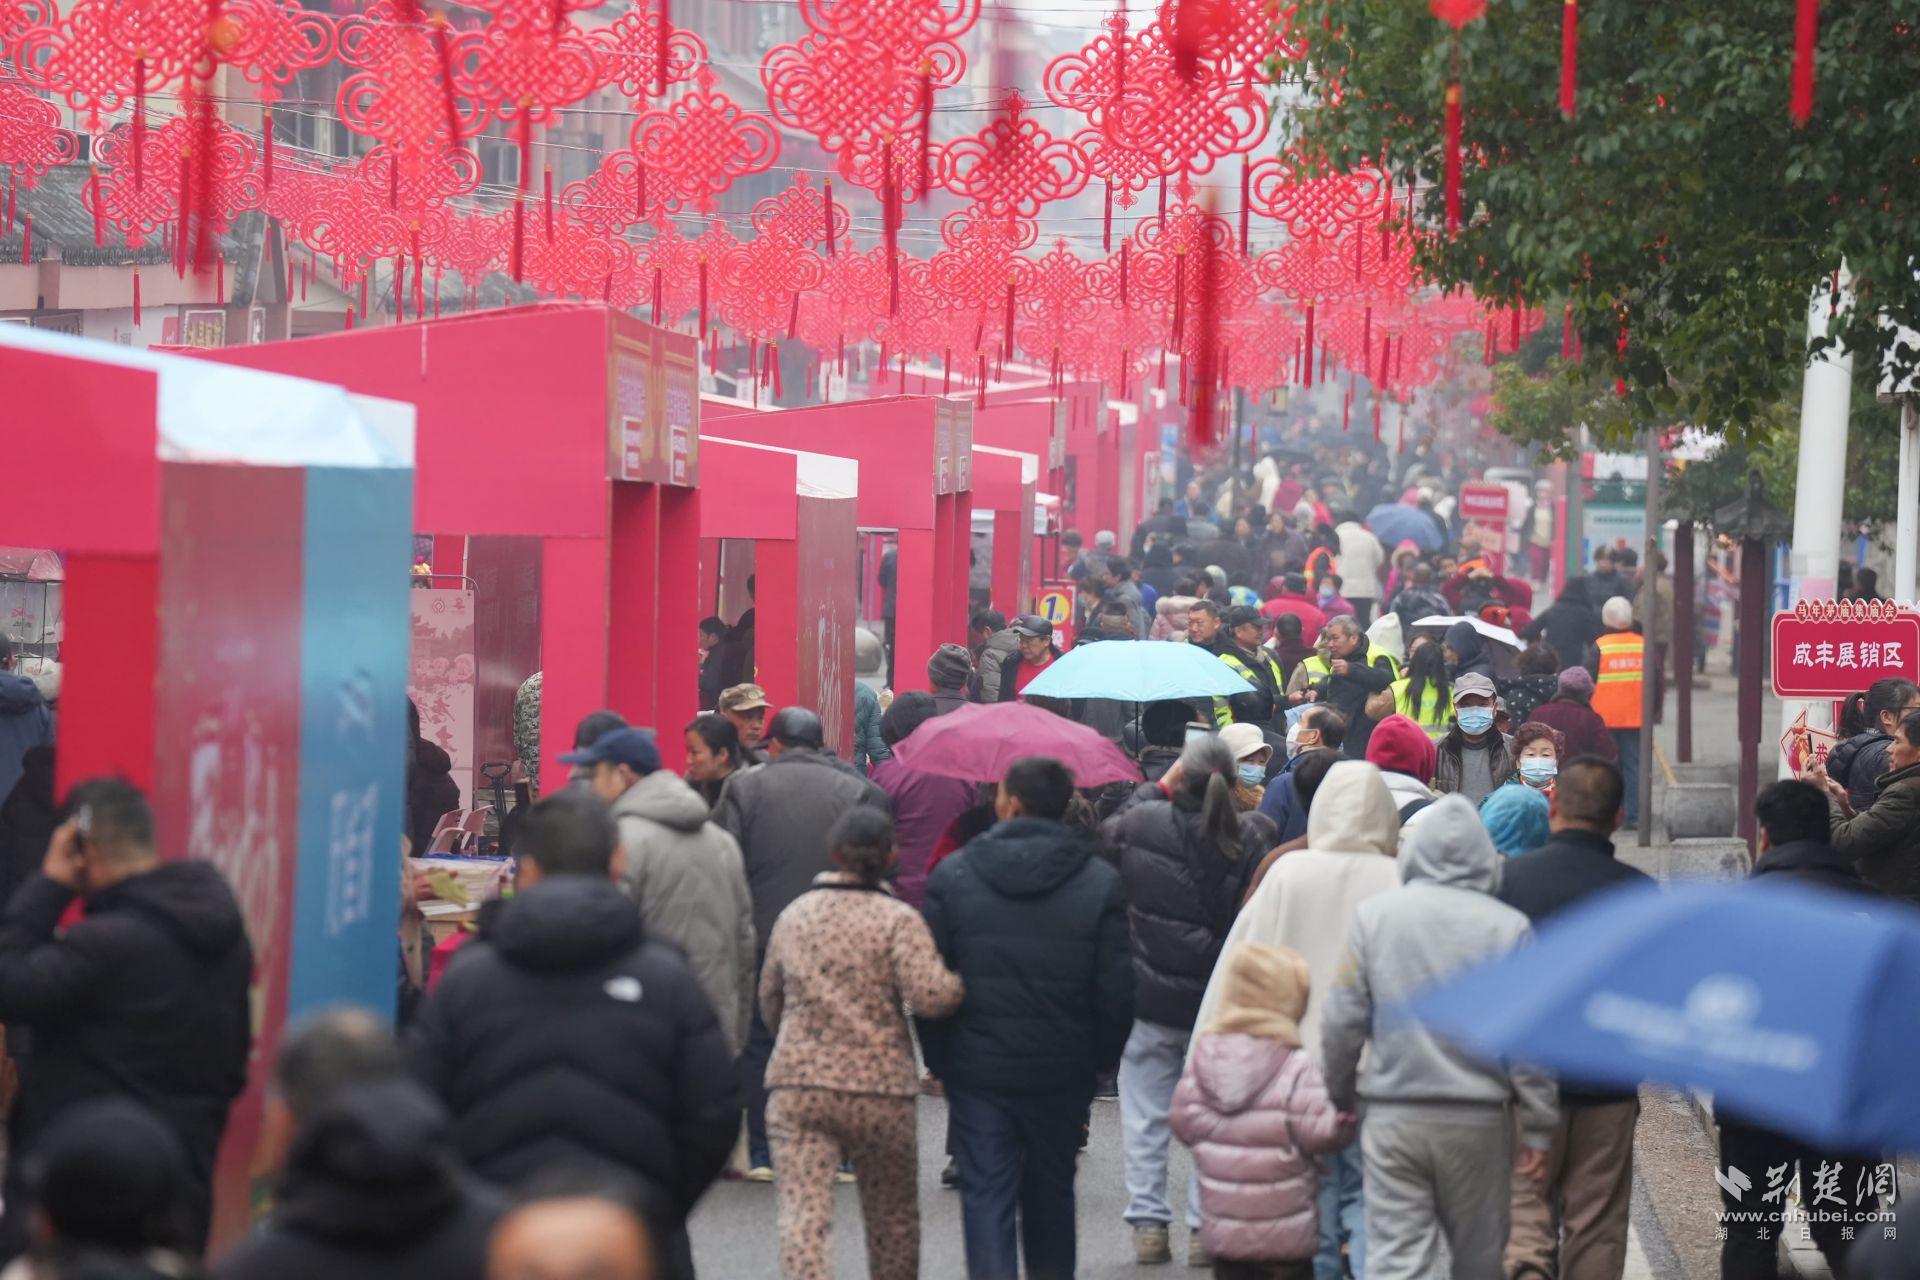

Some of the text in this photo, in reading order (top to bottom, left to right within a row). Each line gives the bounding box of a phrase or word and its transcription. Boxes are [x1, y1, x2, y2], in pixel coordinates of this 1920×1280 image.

[1797, 604, 1895, 618] 马年茅庙集庙会
[1792, 640, 1904, 669] 咸丰展销区
